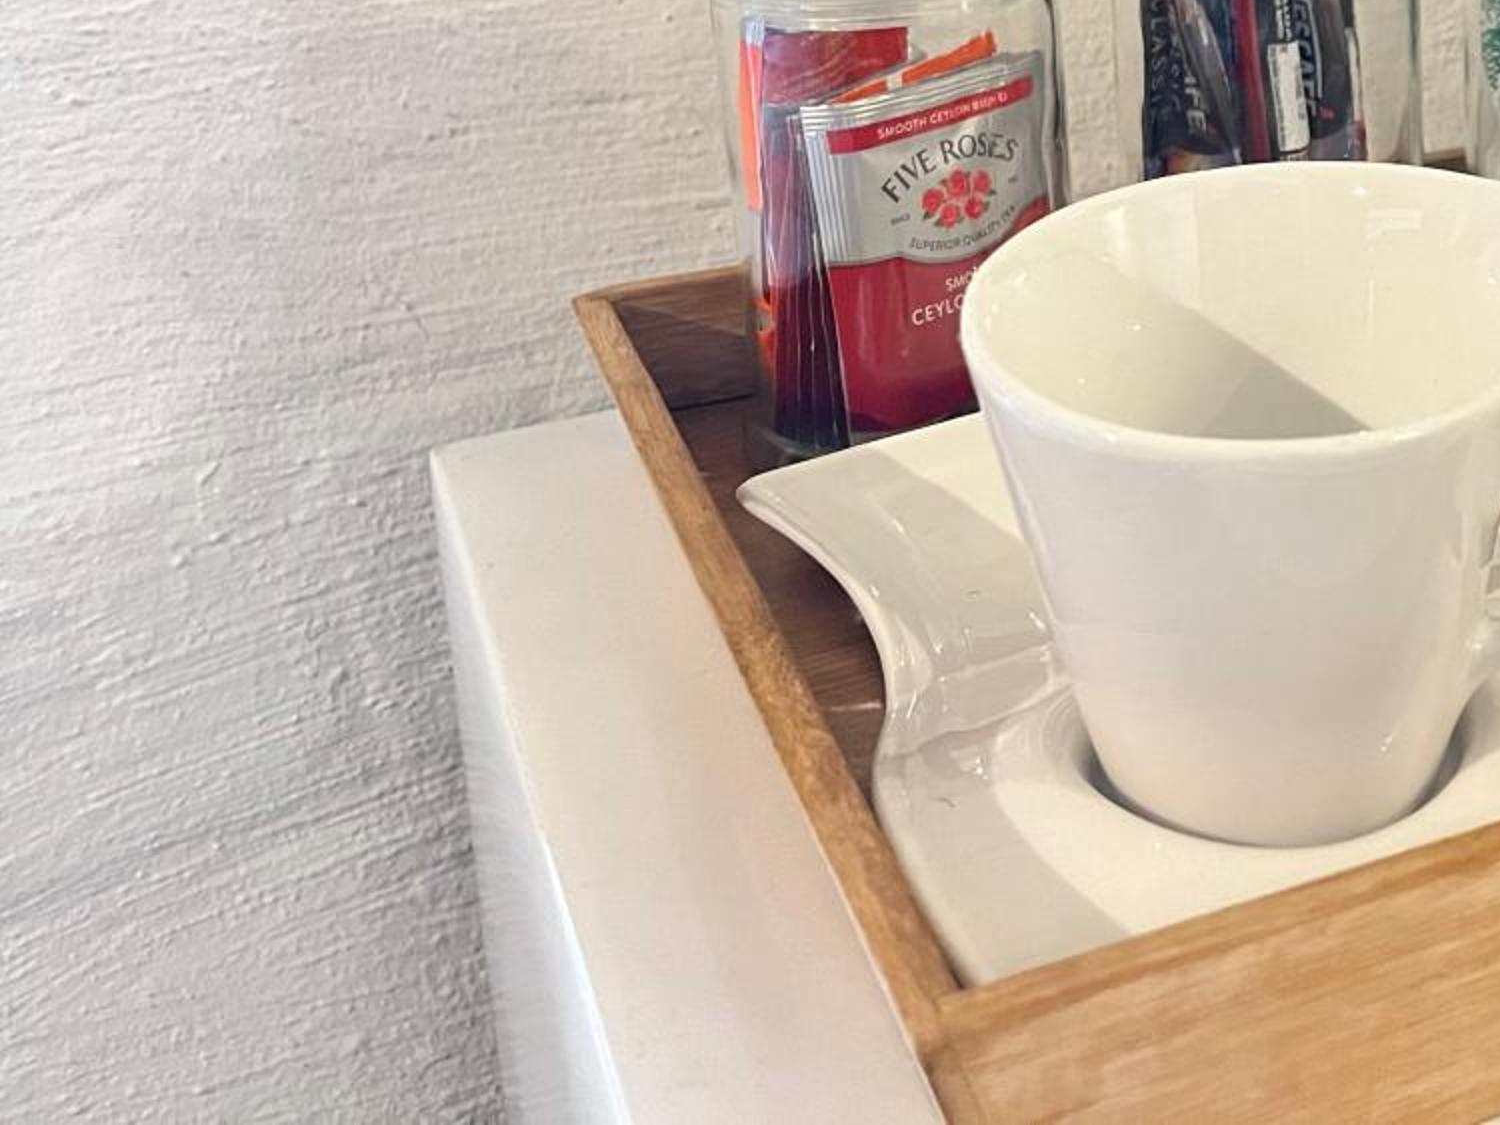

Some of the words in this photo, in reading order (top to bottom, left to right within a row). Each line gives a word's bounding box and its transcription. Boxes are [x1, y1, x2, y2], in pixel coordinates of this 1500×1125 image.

[877, 117, 927, 139] SMOOTH
[929, 103, 971, 124] CEYLON
[881, 149, 936, 203] FIVE
[940, 132, 1019, 164] ROSES
[945, 266, 978, 292] SMO
